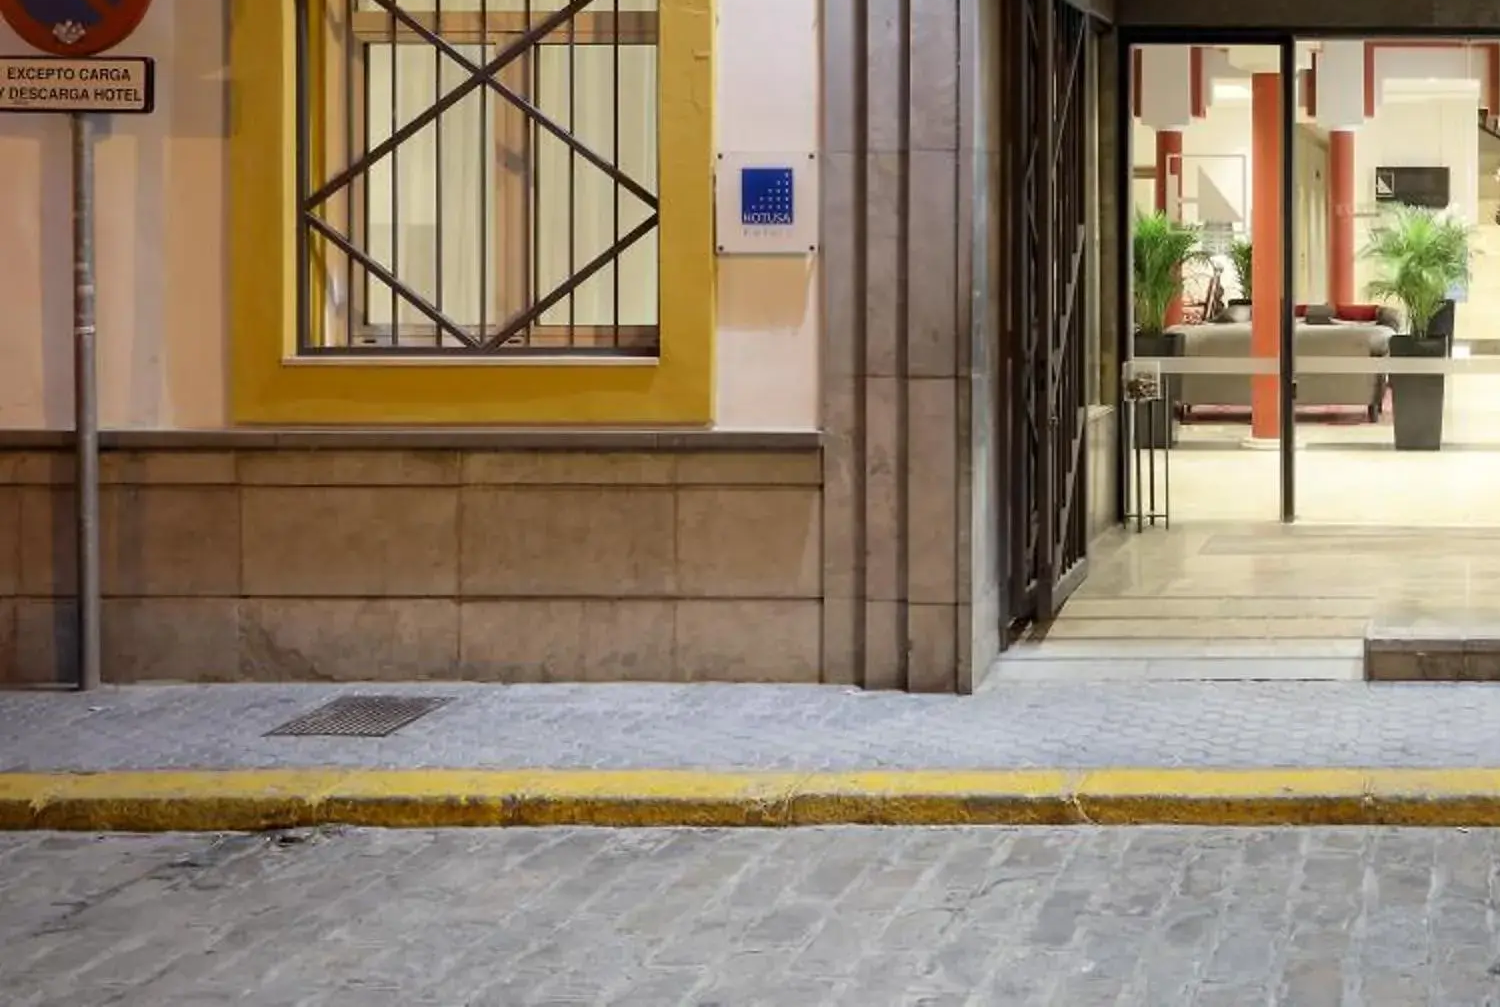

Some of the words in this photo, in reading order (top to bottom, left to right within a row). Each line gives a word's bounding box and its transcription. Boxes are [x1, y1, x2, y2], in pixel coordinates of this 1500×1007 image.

[7, 66, 75, 81] EXCEPTO
[79, 67, 132, 82] CARGA
[8, 86, 90, 101] DESCARGA
[93, 87, 143, 102] HOTEL
